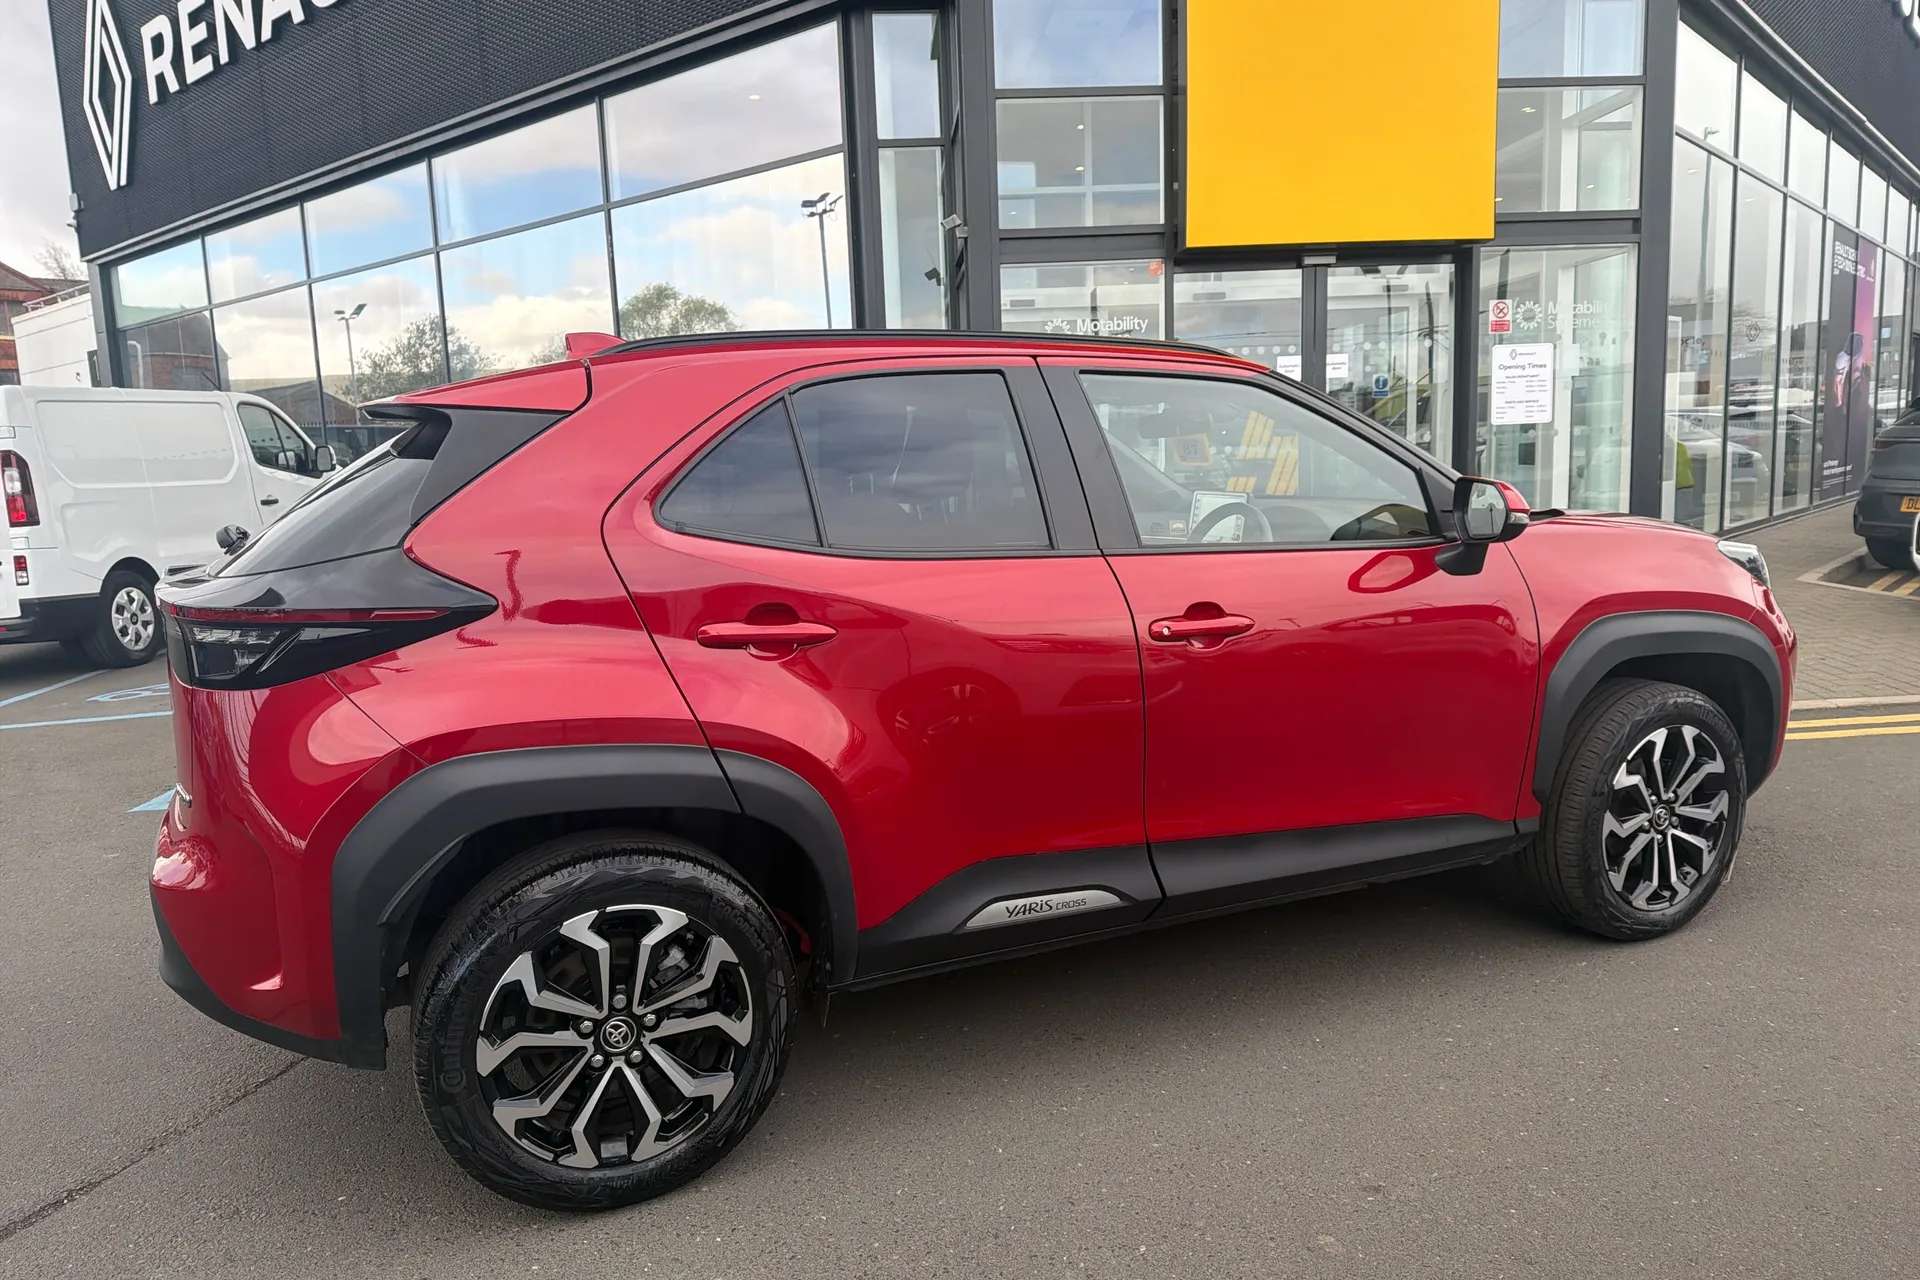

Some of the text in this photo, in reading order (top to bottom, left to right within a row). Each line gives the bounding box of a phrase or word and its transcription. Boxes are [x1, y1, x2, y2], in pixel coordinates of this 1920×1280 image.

[140, 0, 342, 105] RENA
[1076, 315, 1149, 333] Motability
[1547, 315, 1601, 329] Seme
[1498, 362, 1548, 371] Opening Times
[1056, 898, 1087, 911] CROSS
